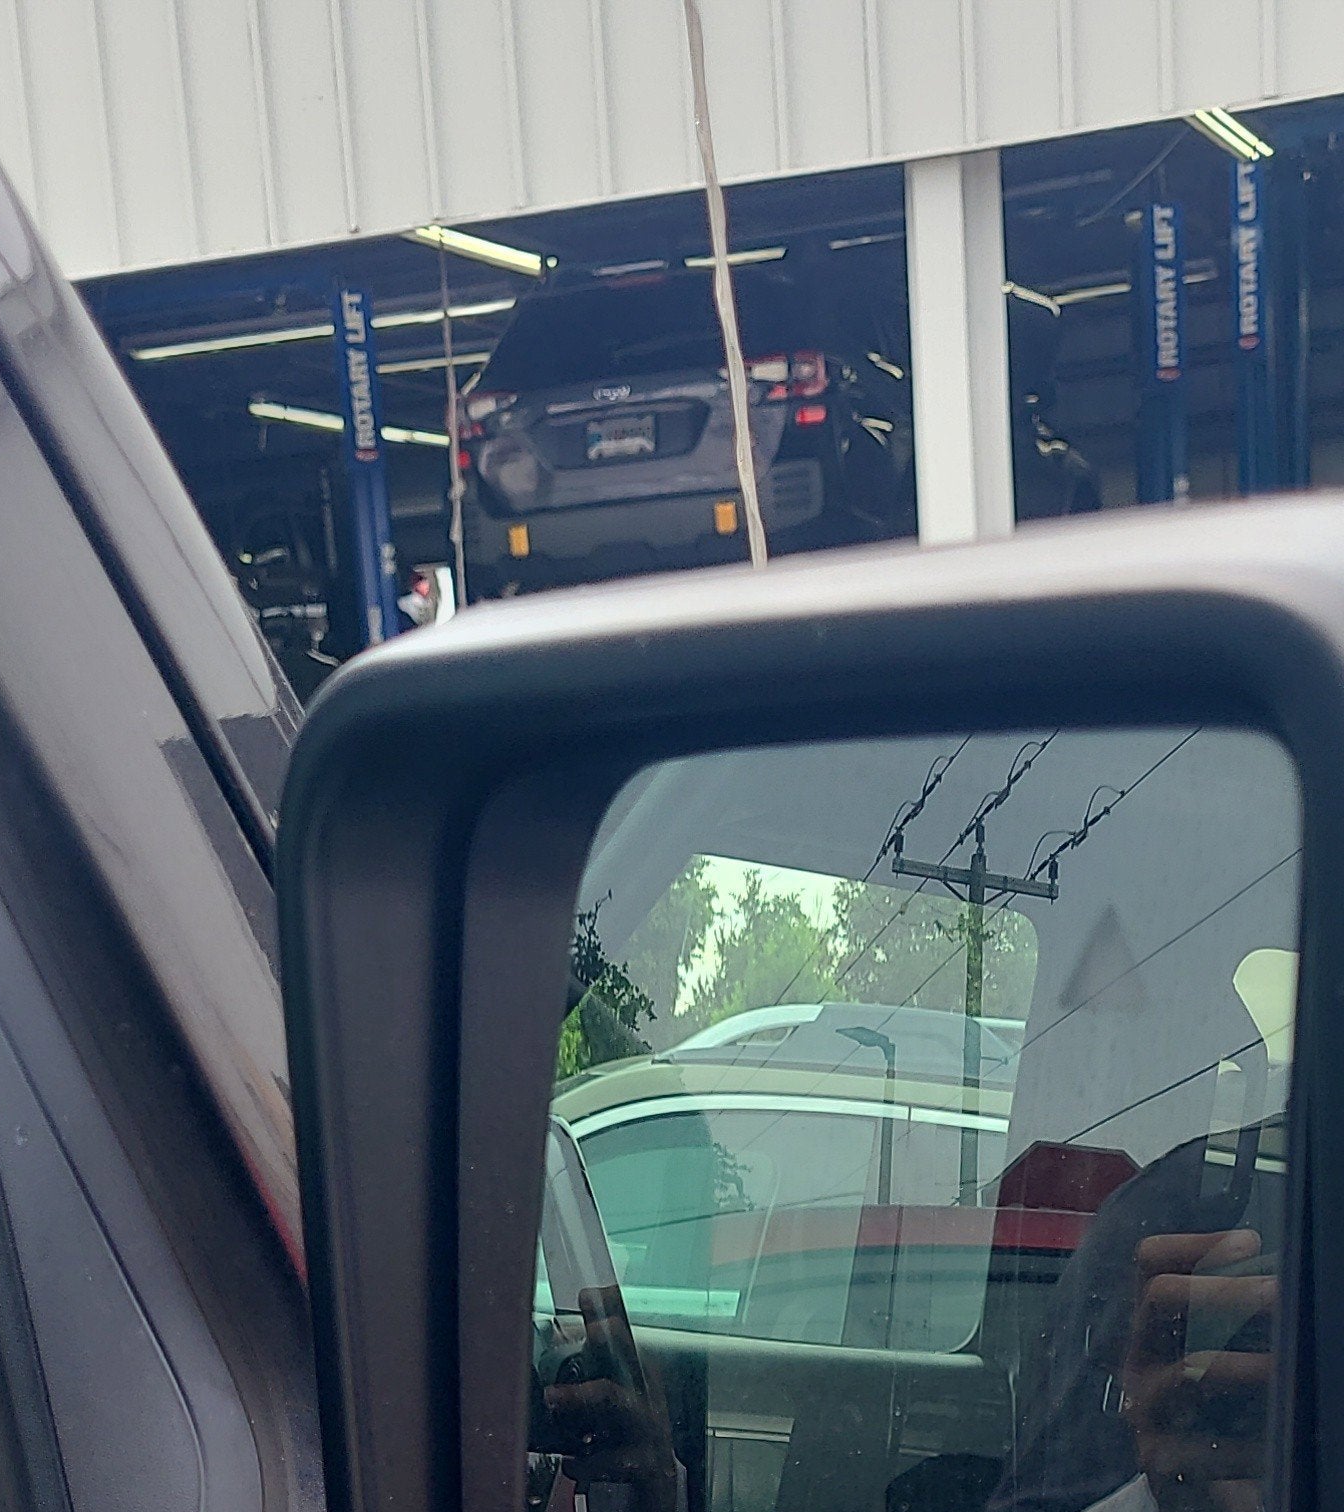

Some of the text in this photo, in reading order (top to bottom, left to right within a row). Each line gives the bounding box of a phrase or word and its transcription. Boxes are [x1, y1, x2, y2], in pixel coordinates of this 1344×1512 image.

[1152, 203, 1180, 367] ROTARY LIFT
[1236, 161, 1260, 336] ROTARY LIFT
[340, 288, 377, 450] ROTARY LIFT
